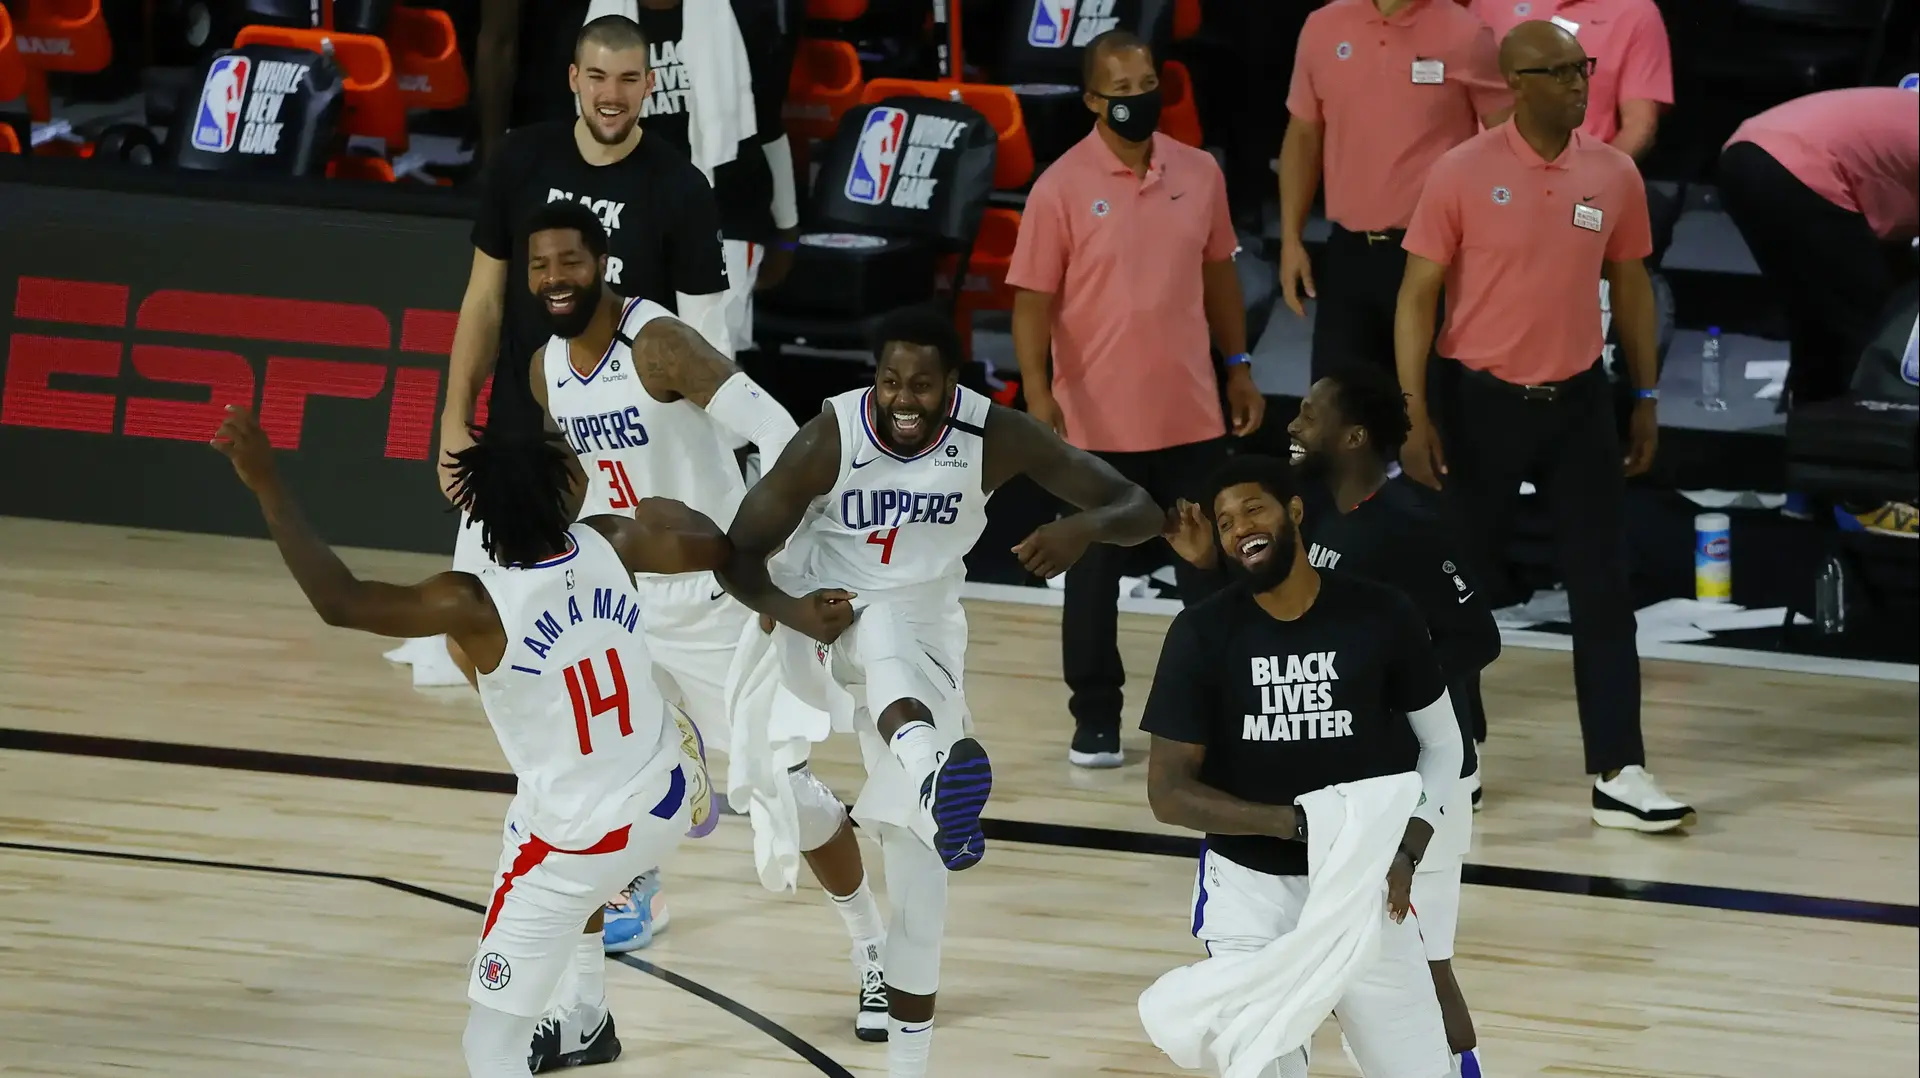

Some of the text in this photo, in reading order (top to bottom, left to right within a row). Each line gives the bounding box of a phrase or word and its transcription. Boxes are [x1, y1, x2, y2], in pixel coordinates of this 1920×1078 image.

[252, 60, 310, 93] WHOLE
[244, 91, 285, 123] NEW
[238, 122, 284, 154] GAME
[602, 373, 628, 383] bumble
[934, 459, 968, 468] bumble
[598, 460, 639, 508] 31
[841, 488, 963, 530] CLIPPERS
[866, 527, 900, 564] 4
[511, 588, 640, 675] I AM A MAN
[1251, 651, 1339, 686] BLACK
[563, 648, 634, 755] 14
[1261, 681, 1333, 714] LIVES
[1242, 710, 1354, 741] MATTER
